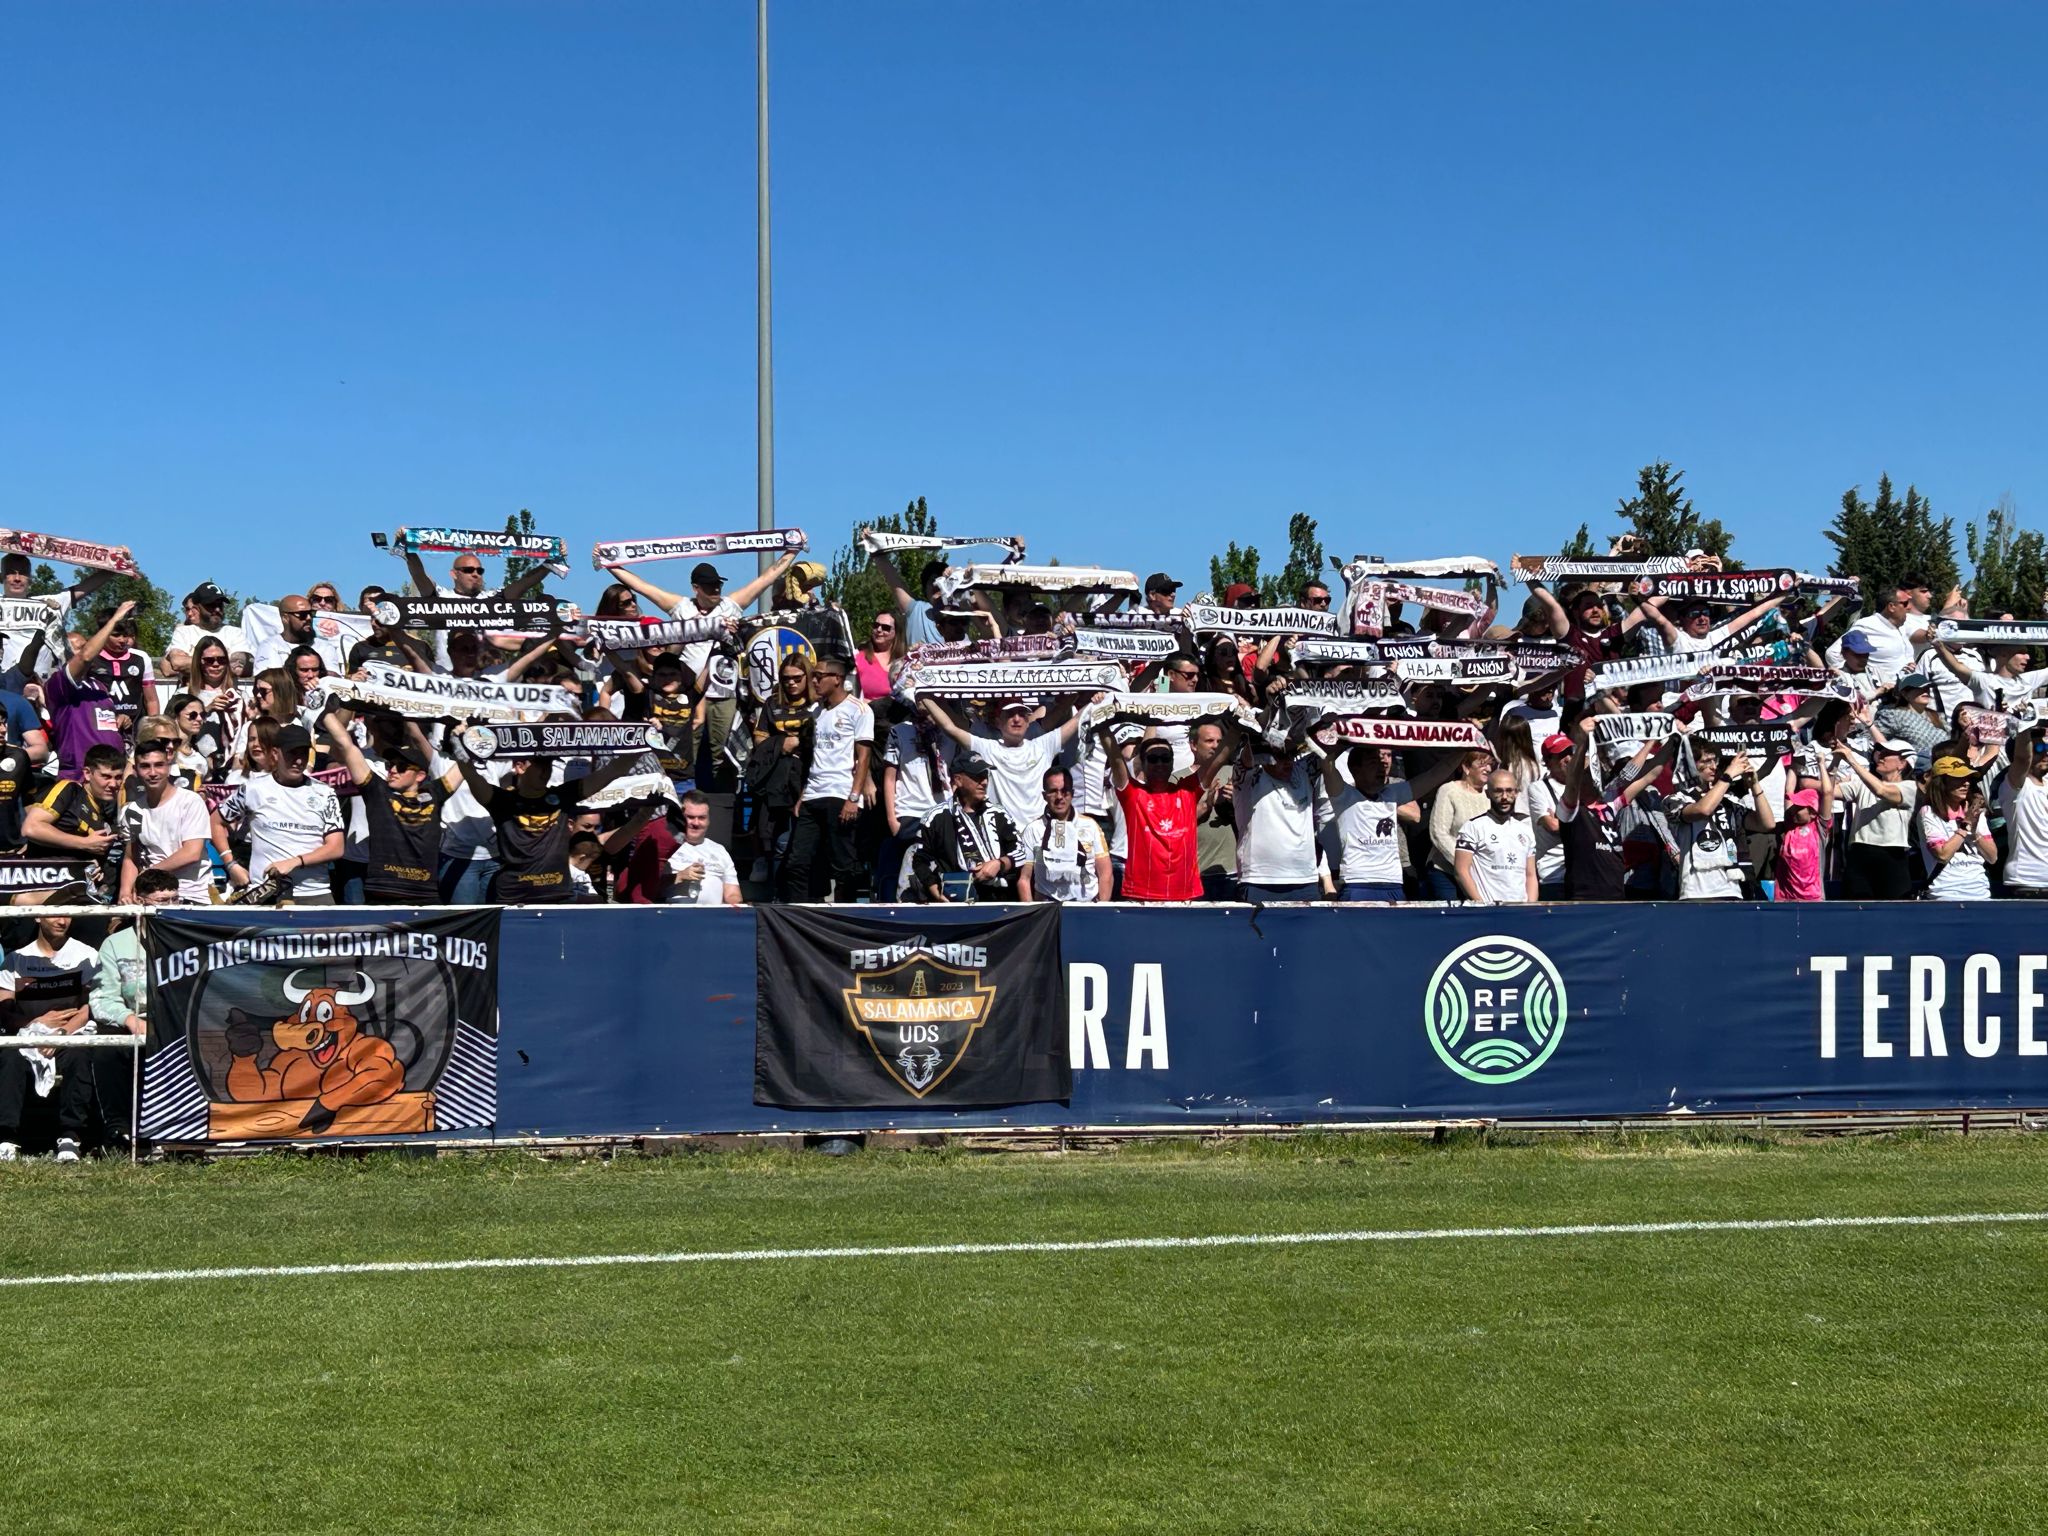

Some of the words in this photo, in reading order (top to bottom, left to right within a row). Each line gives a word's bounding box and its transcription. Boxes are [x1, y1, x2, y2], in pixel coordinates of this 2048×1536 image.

[418, 529, 516, 547] SALAMANCA
[521, 536, 552, 550] UDS
[1658, 580, 1688, 596] UDS
[1717, 579, 1726, 594] X
[1730, 577, 1776, 594] LOCOS
[407, 602, 489, 615] SALAMANCA
[494, 602, 516, 614] C.F.
[523, 601, 550, 613] UDS
[1250, 612, 1325, 630] SALAMANCA
[602, 616, 724, 651] SALAMAN
[1383, 644, 1424, 658] UNIÓN
[1746, 643, 1774, 658] UDS
[938, 669, 974, 684] U.D.
[978, 668, 1093, 684] SALAMANCA
[1407, 661, 1443, 676] HALA
[1467, 660, 1504, 676] UNIÓN
[383, 672, 508, 702] SALAMANCA
[513, 686, 552, 703] UDS
[1288, 680, 1365, 698] LAMANCA
[1368, 681, 1399, 698] UDS
[1092, 702, 1200, 723] SALAMANCA
[498, 728, 537, 748] U.D.
[542, 726, 645, 747] SALAMANCA
[1335, 720, 1370, 739] U.D.
[1373, 722, 1474, 742] SALAMANCA
[1751, 730, 1765, 743] C.F.
[1770, 729, 1788, 741] UDS
[155, 946, 200, 987] LOS
[207, 932, 438, 971] INCONDICIONALES
[446, 936, 488, 971] UDS
[850, 935, 987, 970] PETROLEROS
[940, 982, 964, 992] 2023
[1474, 988, 1519, 1007] RF
[1810, 953, 2048, 1059] TERCE
[863, 1000, 976, 1019] SALAMANCA
[1474, 1012, 1519, 1032] EF
[900, 1024, 939, 1044] UDS
